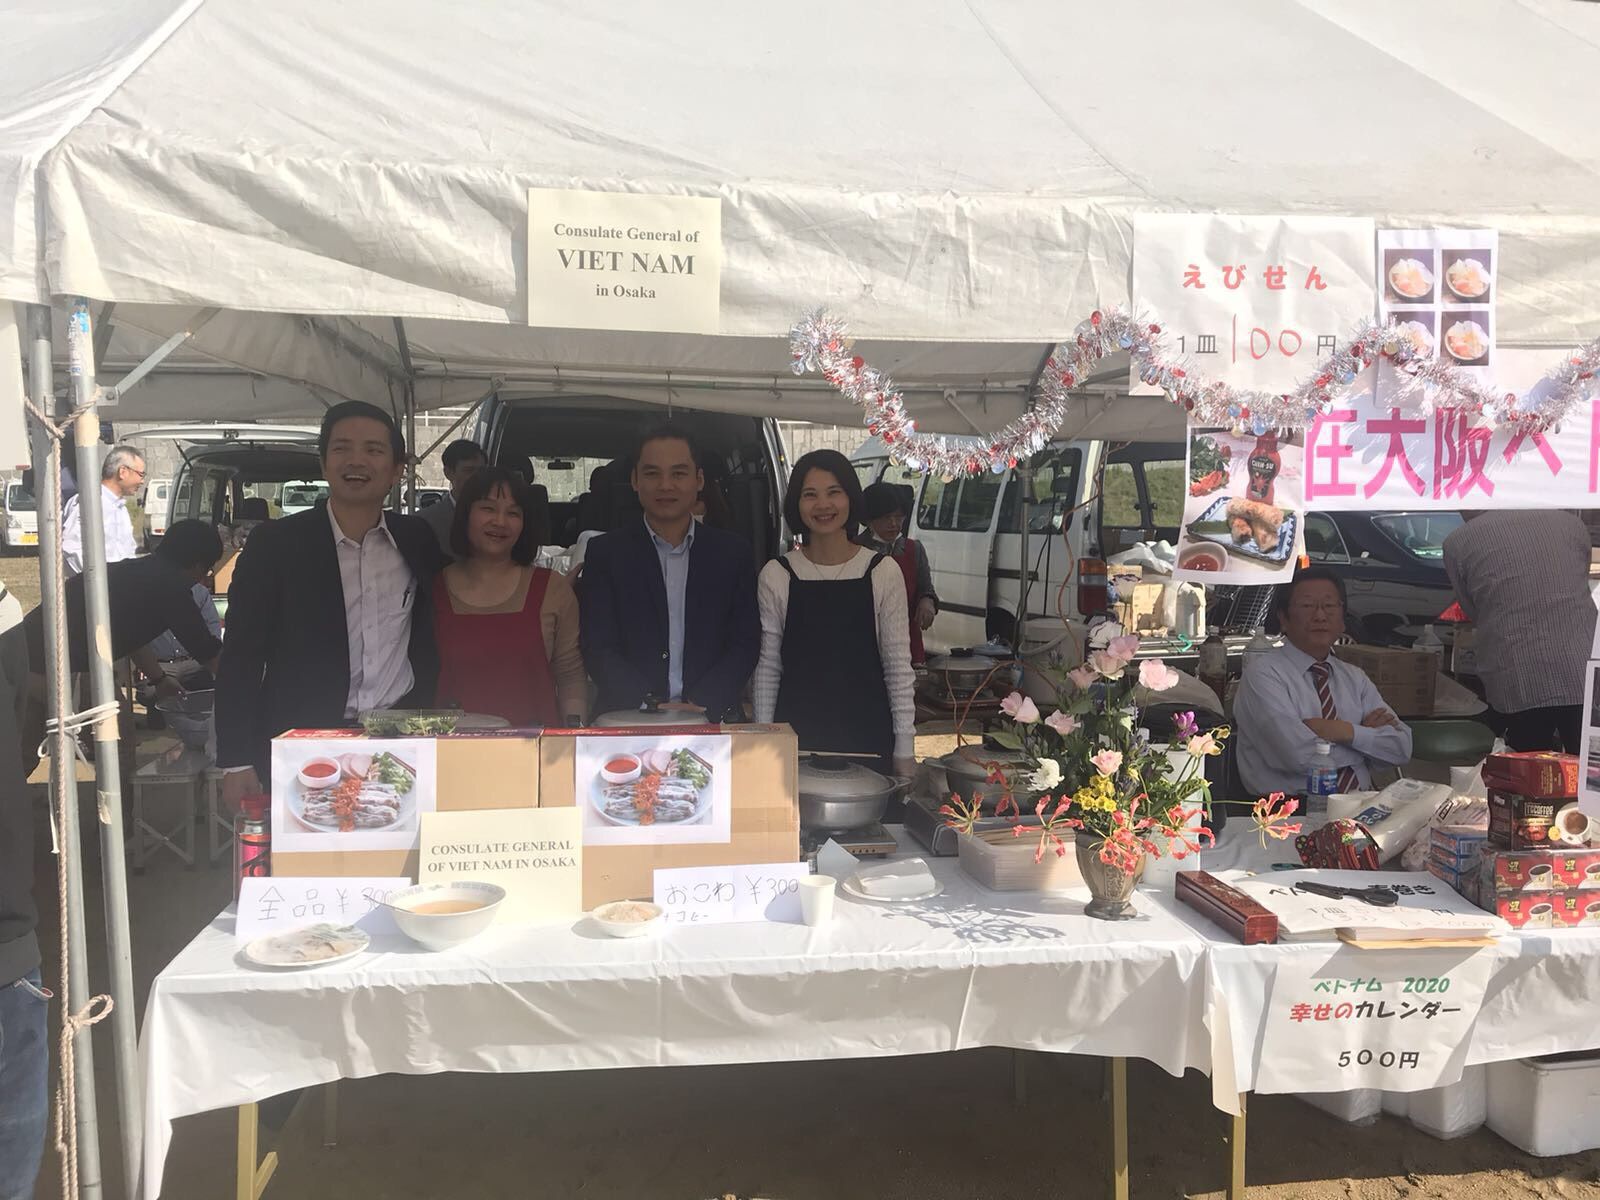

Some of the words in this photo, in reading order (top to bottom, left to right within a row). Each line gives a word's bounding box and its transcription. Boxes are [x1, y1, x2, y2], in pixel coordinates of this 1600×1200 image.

[554, 223, 623, 239] Consulate
[627, 226, 681, 242] General
[685, 230, 700, 243] of
[557, 248, 623, 271] VIET
[631, 252, 696, 275] NAM
[1182, 263, 1328, 291] えびせん
[596, 284, 609, 296] in
[613, 285, 656, 299] Osaka
[431, 843, 509, 856] CONSULATE
[512, 840, 574, 852] GENERAL
[427, 862, 446, 872] OF
[449, 860, 480, 872] VIET
[482, 859, 512, 870] NAM
[516, 859, 530, 869] IN
[532, 856, 577, 868] OSAKA
[664, 881, 736, 905] おこわ
[1314, 978, 1382, 995] ベトナム
[1402, 977, 1450, 994] 2020
[1290, 1001, 1461, 1022] 幸せのカレンダー
